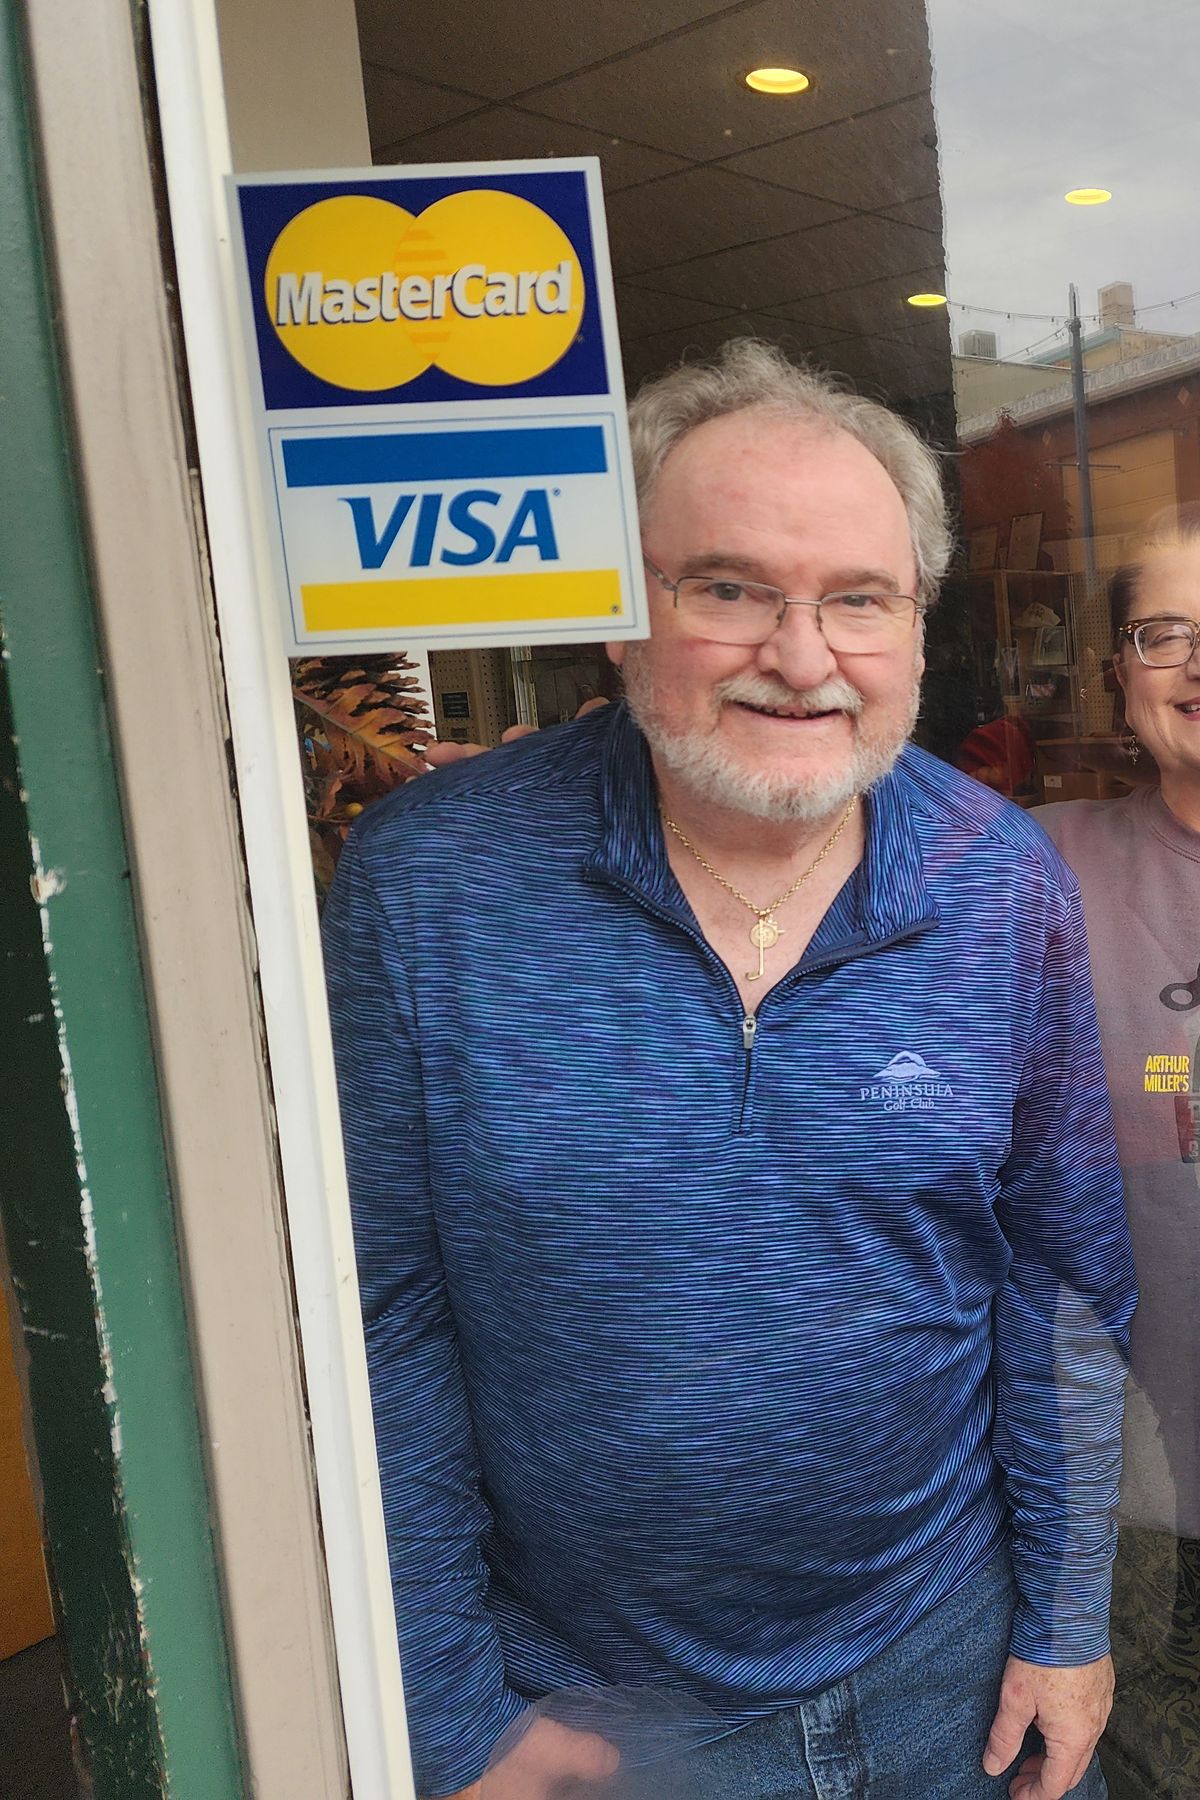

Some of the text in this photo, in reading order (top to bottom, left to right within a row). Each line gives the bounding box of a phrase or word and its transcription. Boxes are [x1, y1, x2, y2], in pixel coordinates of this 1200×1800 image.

[276, 262, 571, 327] MasterCard
[337, 488, 560, 570] VISA
[1145, 1055, 1189, 1073] ARTHUR
[860, 1084, 954, 1101] PENINSULA
[1144, 1074, 1189, 1093] MILLER'S
